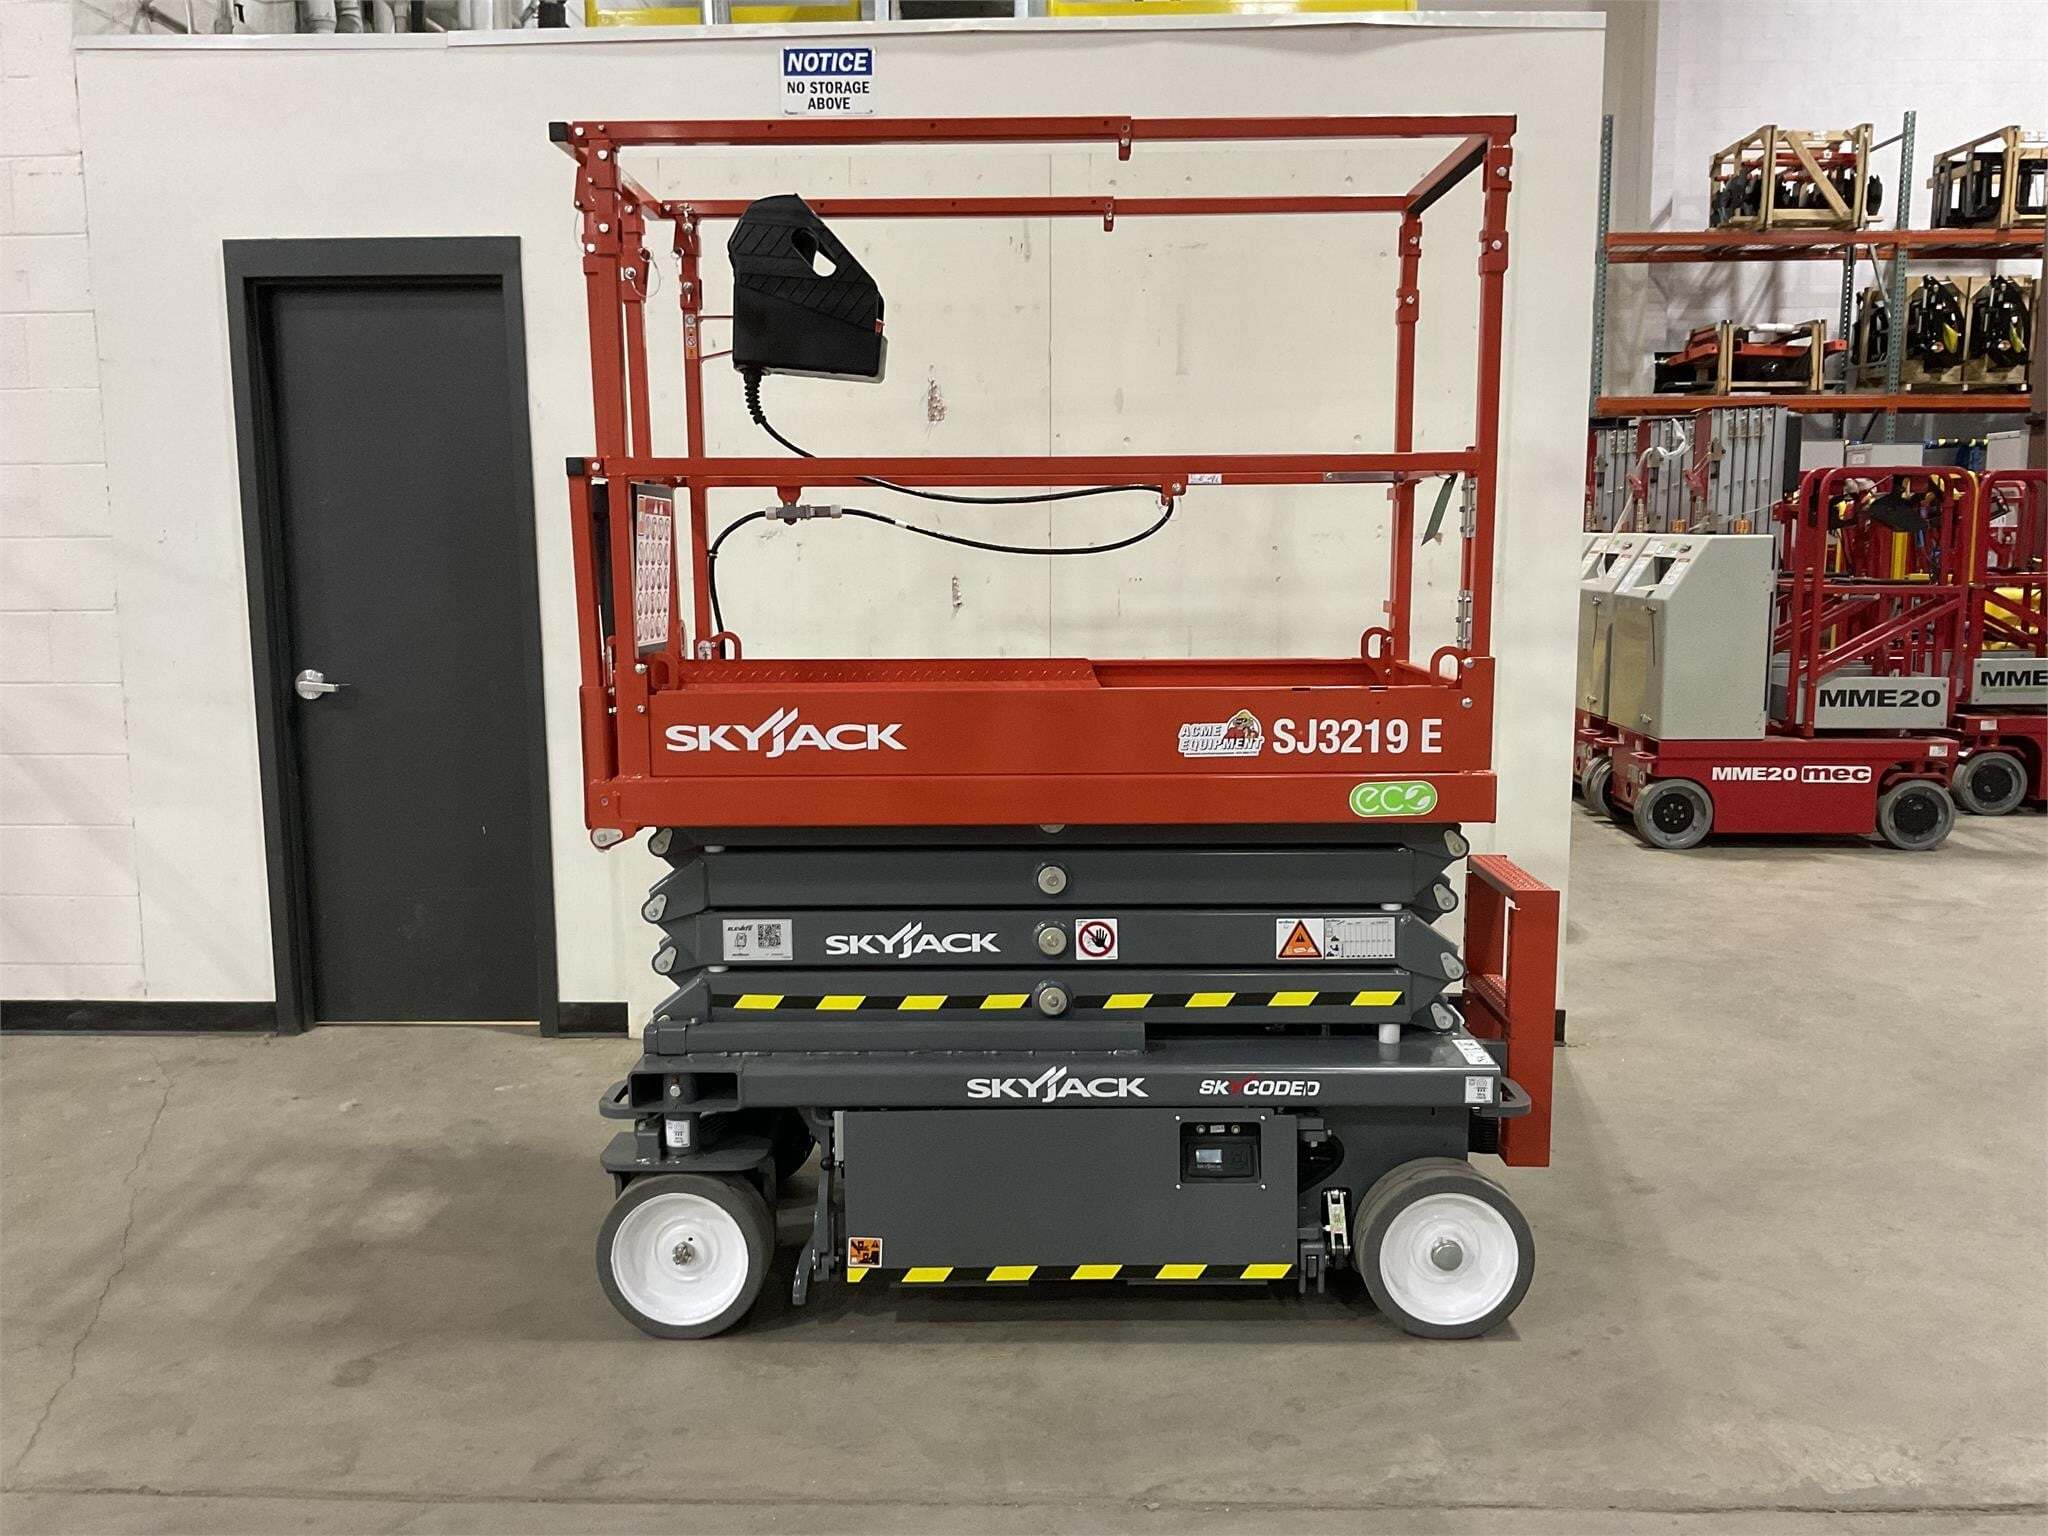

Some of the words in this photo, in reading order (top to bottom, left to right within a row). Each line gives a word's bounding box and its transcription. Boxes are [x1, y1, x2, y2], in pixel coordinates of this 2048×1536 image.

[787, 53, 869, 72] NOTICE
[787, 81, 805, 94] NO
[810, 81, 870, 94] STORAGE
[808, 97, 851, 110] ABOVE
[1981, 670, 2048, 687] MME
[1818, 689, 1941, 708] MME20
[665, 707, 908, 758] SKYJACK
[1181, 725, 1222, 738] ACME
[1272, 718, 1409, 754] SJ3219
[1421, 718, 1443, 754] E
[1180, 738, 1263, 752] EQUIPMENT
[1712, 766, 1797, 782] MME20
[1802, 767, 1871, 782] mec
[1355, 785, 1431, 813] eco
[825, 922, 1001, 959] SKYJACK
[967, 1066, 1149, 1103] SKYJACK
